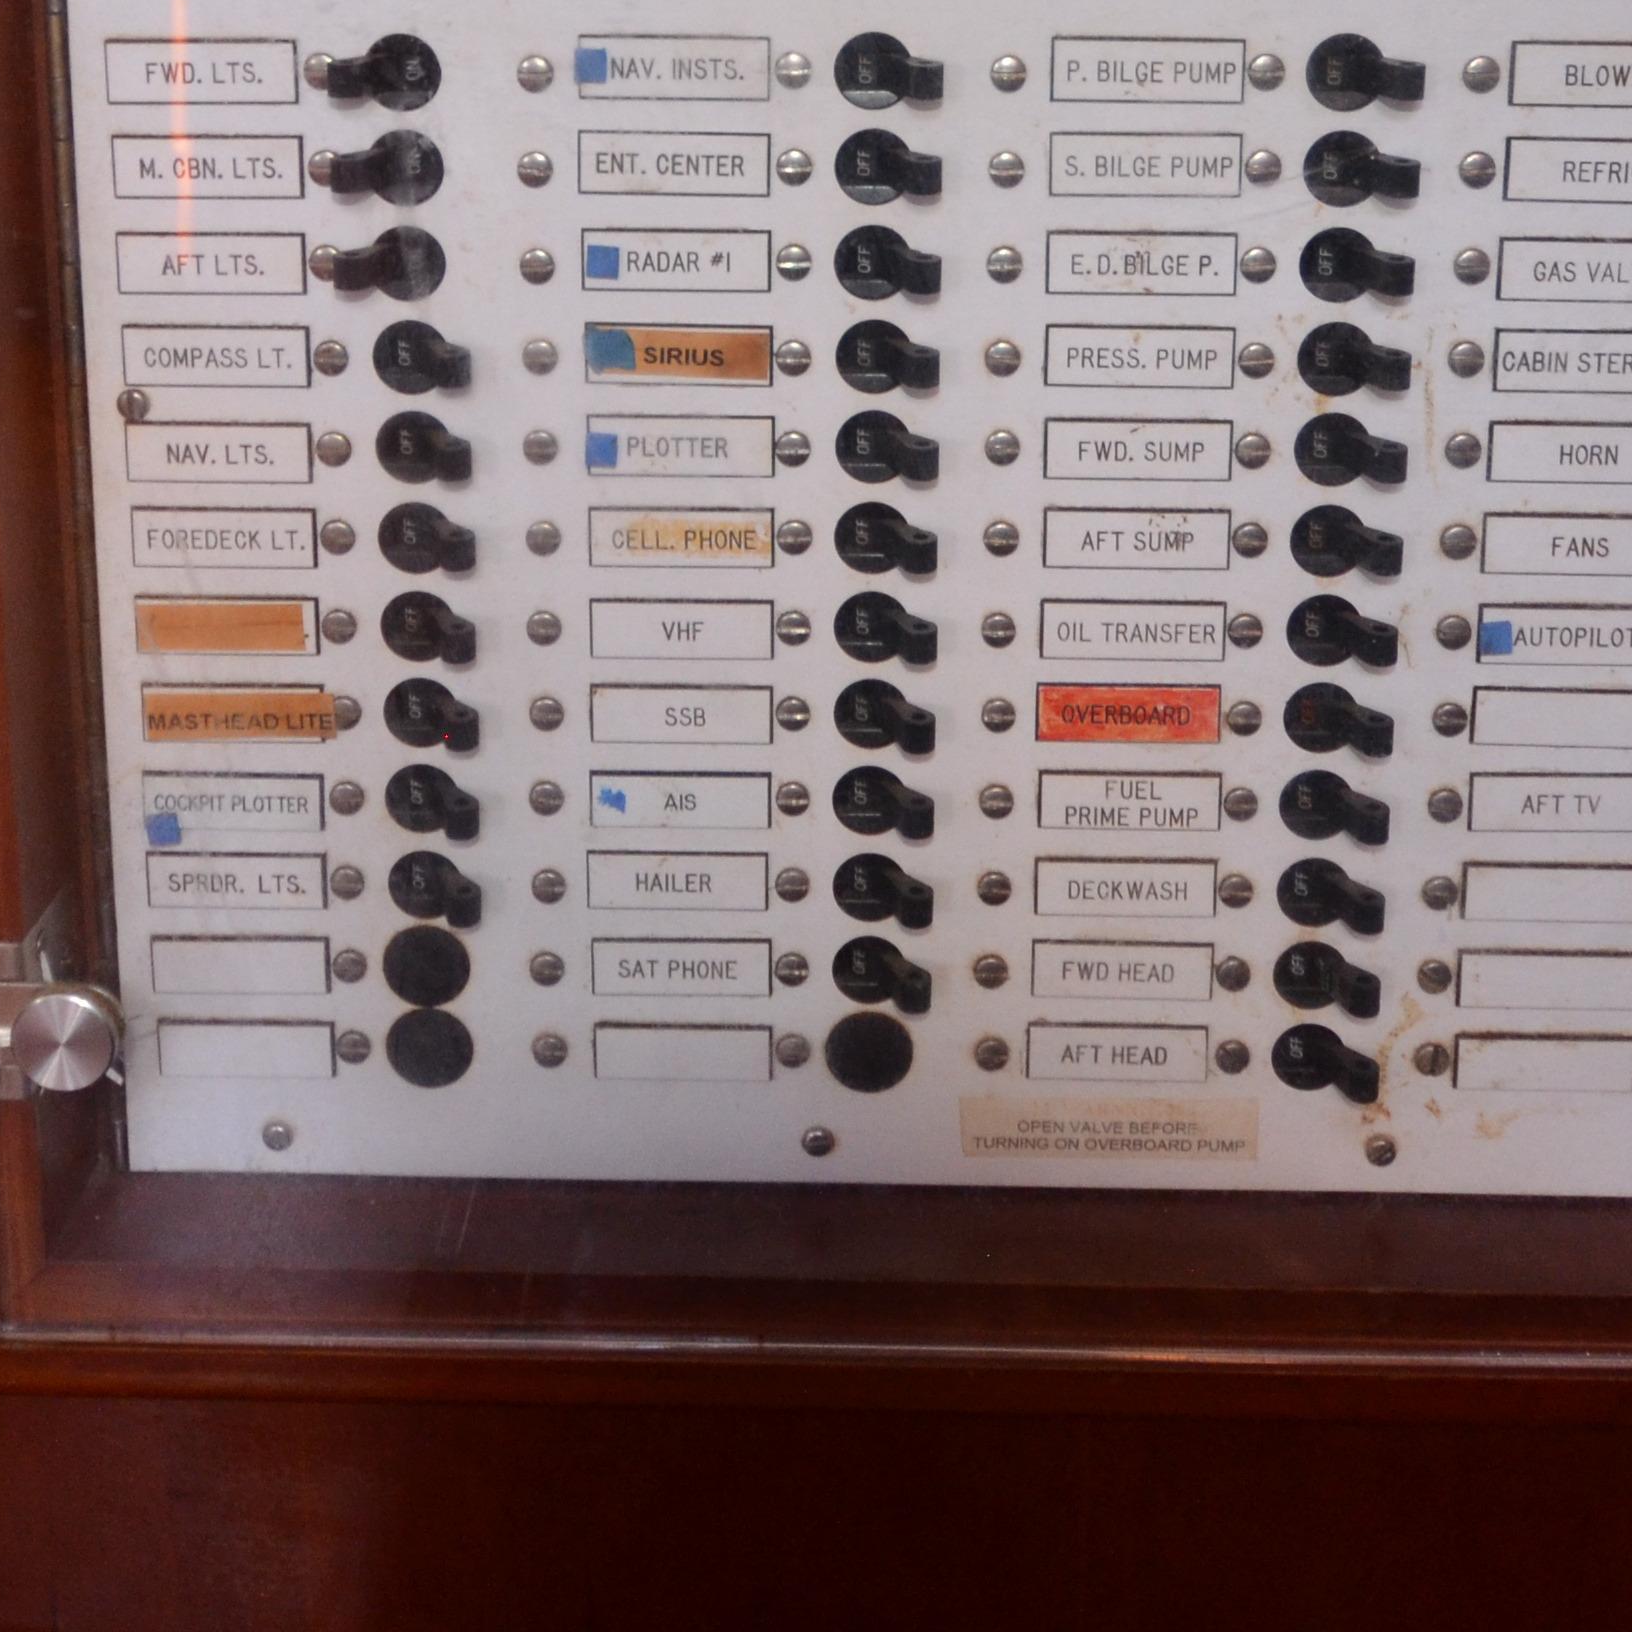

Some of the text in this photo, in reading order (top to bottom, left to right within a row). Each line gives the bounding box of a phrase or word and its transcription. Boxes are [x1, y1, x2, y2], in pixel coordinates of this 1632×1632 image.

[146, 63, 262, 84] FWD. LTS.
[610, 59, 744, 80] NAV. INSTS.
[1067, 62, 1236, 83] P. BILGE PUMP
[139, 159, 282, 179] M. CBN. LTS.
[596, 153, 744, 176] ENT. CENTER
[1065, 156, 1233, 177] S. BILGE PUMP
[162, 255, 265, 276] AFT LTS.
[627, 251, 730, 272] RADAR #1
[1199, 256, 1218, 276] P.
[1533, 261, 1576, 282] GAS
[144, 348, 292, 368] COMPASS LT.
[644, 347, 725, 366] SIRIUS
[1067, 348, 1217, 369] PRESS. PUMP
[1502, 351, 1568, 373] CABIN
[167, 444, 274, 465] NAV. LTS.
[626, 437, 729, 458] PLOTTER
[1078, 442, 1205, 462] FWD. SUMP
[1559, 445, 1618, 465] HORN
[147, 529, 305, 550] FOREDECK LT.
[612, 530, 756, 550] CELL. PHONE
[1081, 531, 1194, 552] AFT SUMP
[1551, 537, 1609, 557] FANS
[662, 622, 704, 641] VHF
[1057, 622, 1216, 643] OIL TRANSFER
[287, 714, 333, 730] LITE
[665, 709, 706, 726] SSB
[1061, 706, 1191, 726] OVERBOARD
[1105, 781, 1161, 801] FUEL
[154, 794, 308, 814] COCKPIT PLOTTER
[664, 794, 696, 811] AIS
[1521, 795, 1601, 815] AFT TV
[1065, 807, 1198, 827] PRIME PUMP
[169, 874, 306, 894] SPRDR. LTS.
[635, 873, 711, 892] HAILER
[618, 960, 738, 980] SAT PHONE
[1062, 962, 1174, 983] FWD HEAD
[1061, 1046, 1168, 1064] AFT HEAD
[1017, 1121, 1064, 1134] OPEN
[1070, 1122, 1123, 1134] VALVE
[974, 1137, 1246, 1153] TURNING ON OVERBOARD PUMP
